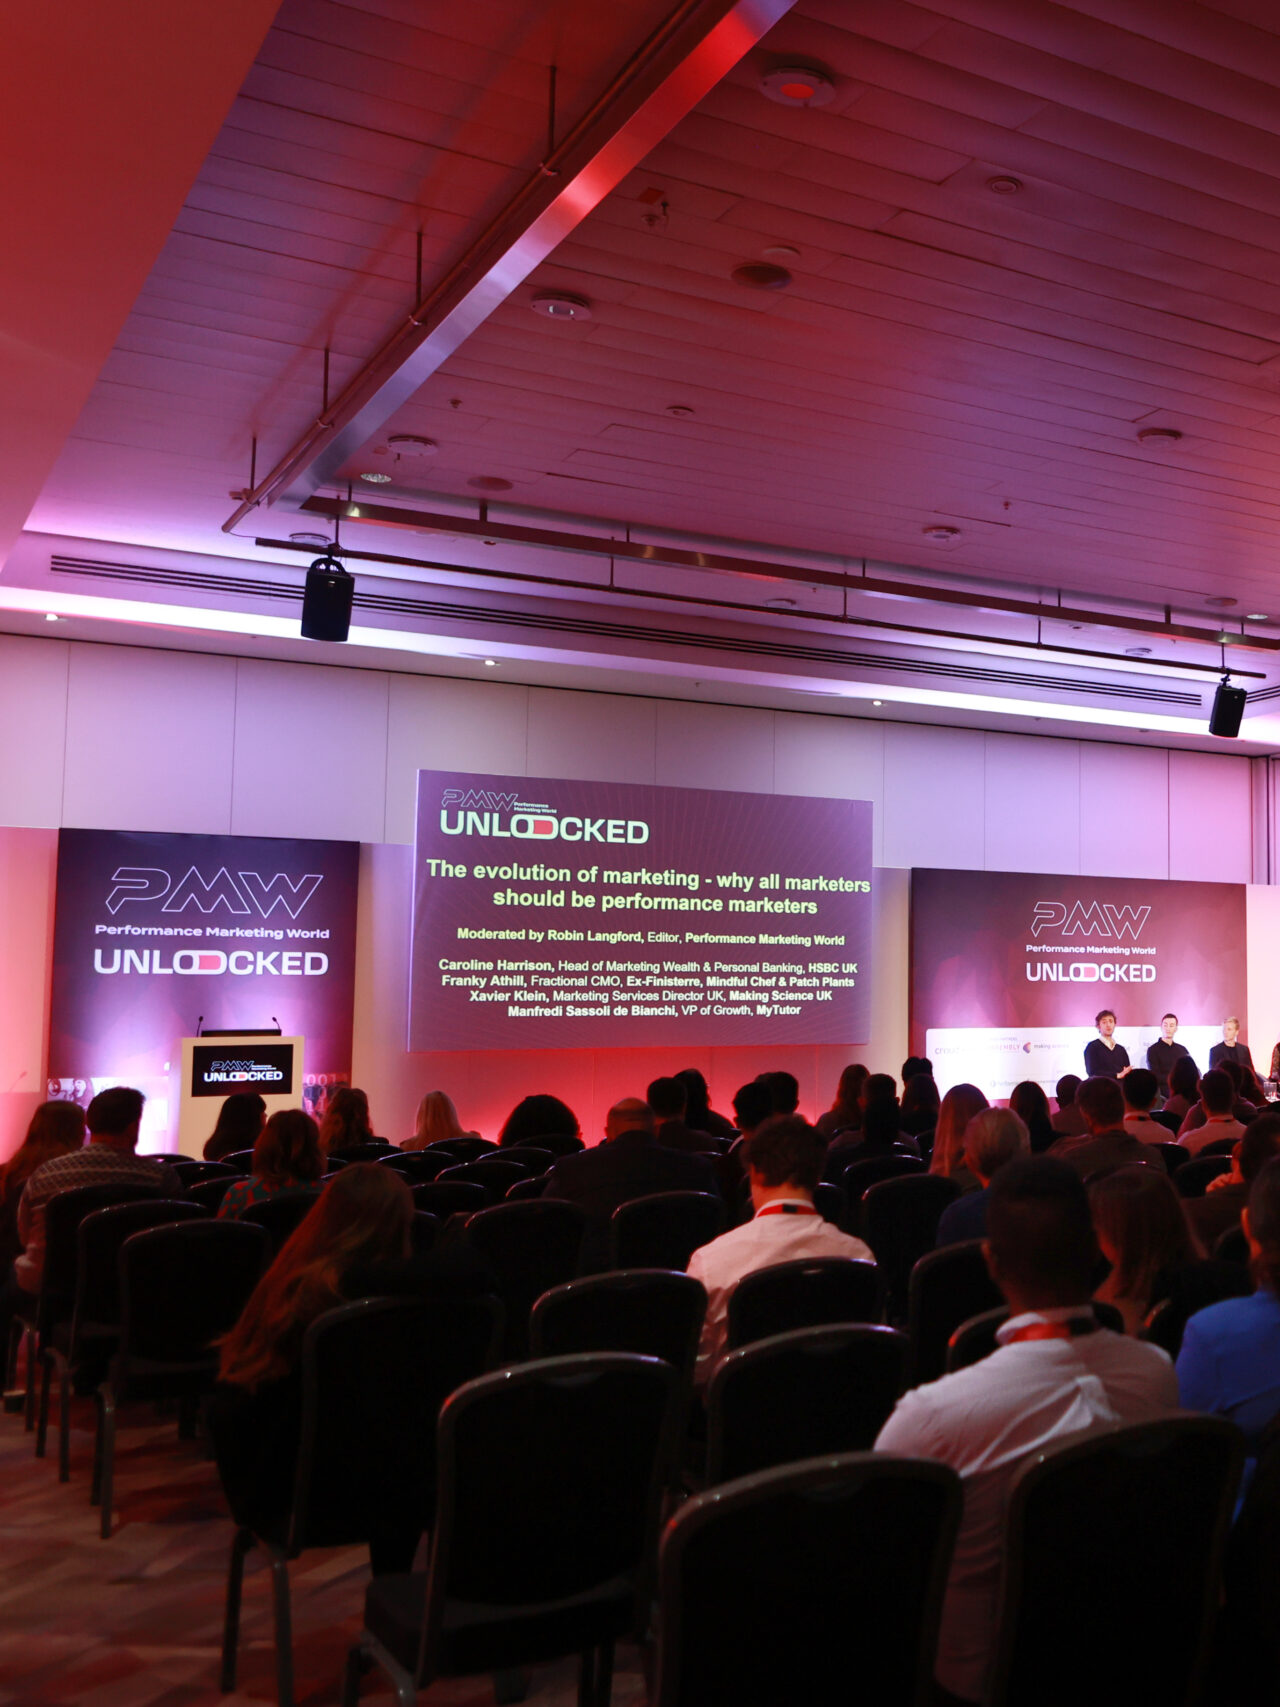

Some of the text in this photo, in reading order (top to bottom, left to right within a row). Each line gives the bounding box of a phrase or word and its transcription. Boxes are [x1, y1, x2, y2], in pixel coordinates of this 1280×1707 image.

[441, 788, 518, 812] PMW
[426, 859, 467, 877] The
[473, 862, 571, 882] evolution
[577, 866, 598, 883] of
[603, 868, 700, 891] marketing
[717, 872, 754, 892] why
[759, 873, 780, 889] all
[785, 875, 871, 892] marketers
[105, 865, 324, 920] PMW
[493, 888, 818, 914] should be performance marketers
[1031, 900, 1152, 940] PMW
[95, 924, 330, 940] Performance Marketing World
[457, 927, 845, 947] Moderated by Robin Langford, Editor, Performance Marketing World
[1026, 944, 1156, 956] Performance Marketing World
[439, 959, 858, 975] Caroline Harrison, Head of Marketing Wealth & Personal Banking, HSBC UK
[441, 975, 855, 988] Franky Athill, Fractional CMO, Ex-Finisterre, Mindful Chef & Patch Plants
[469, 990, 833, 1003] Xavier Klein, Marketing Services Director UK, Making Science UK
[508, 1005, 802, 1017] Manfredi Sassoli de Bianchi, VP of Growth, MyTutor
[211, 1060, 254, 1071] PMW
